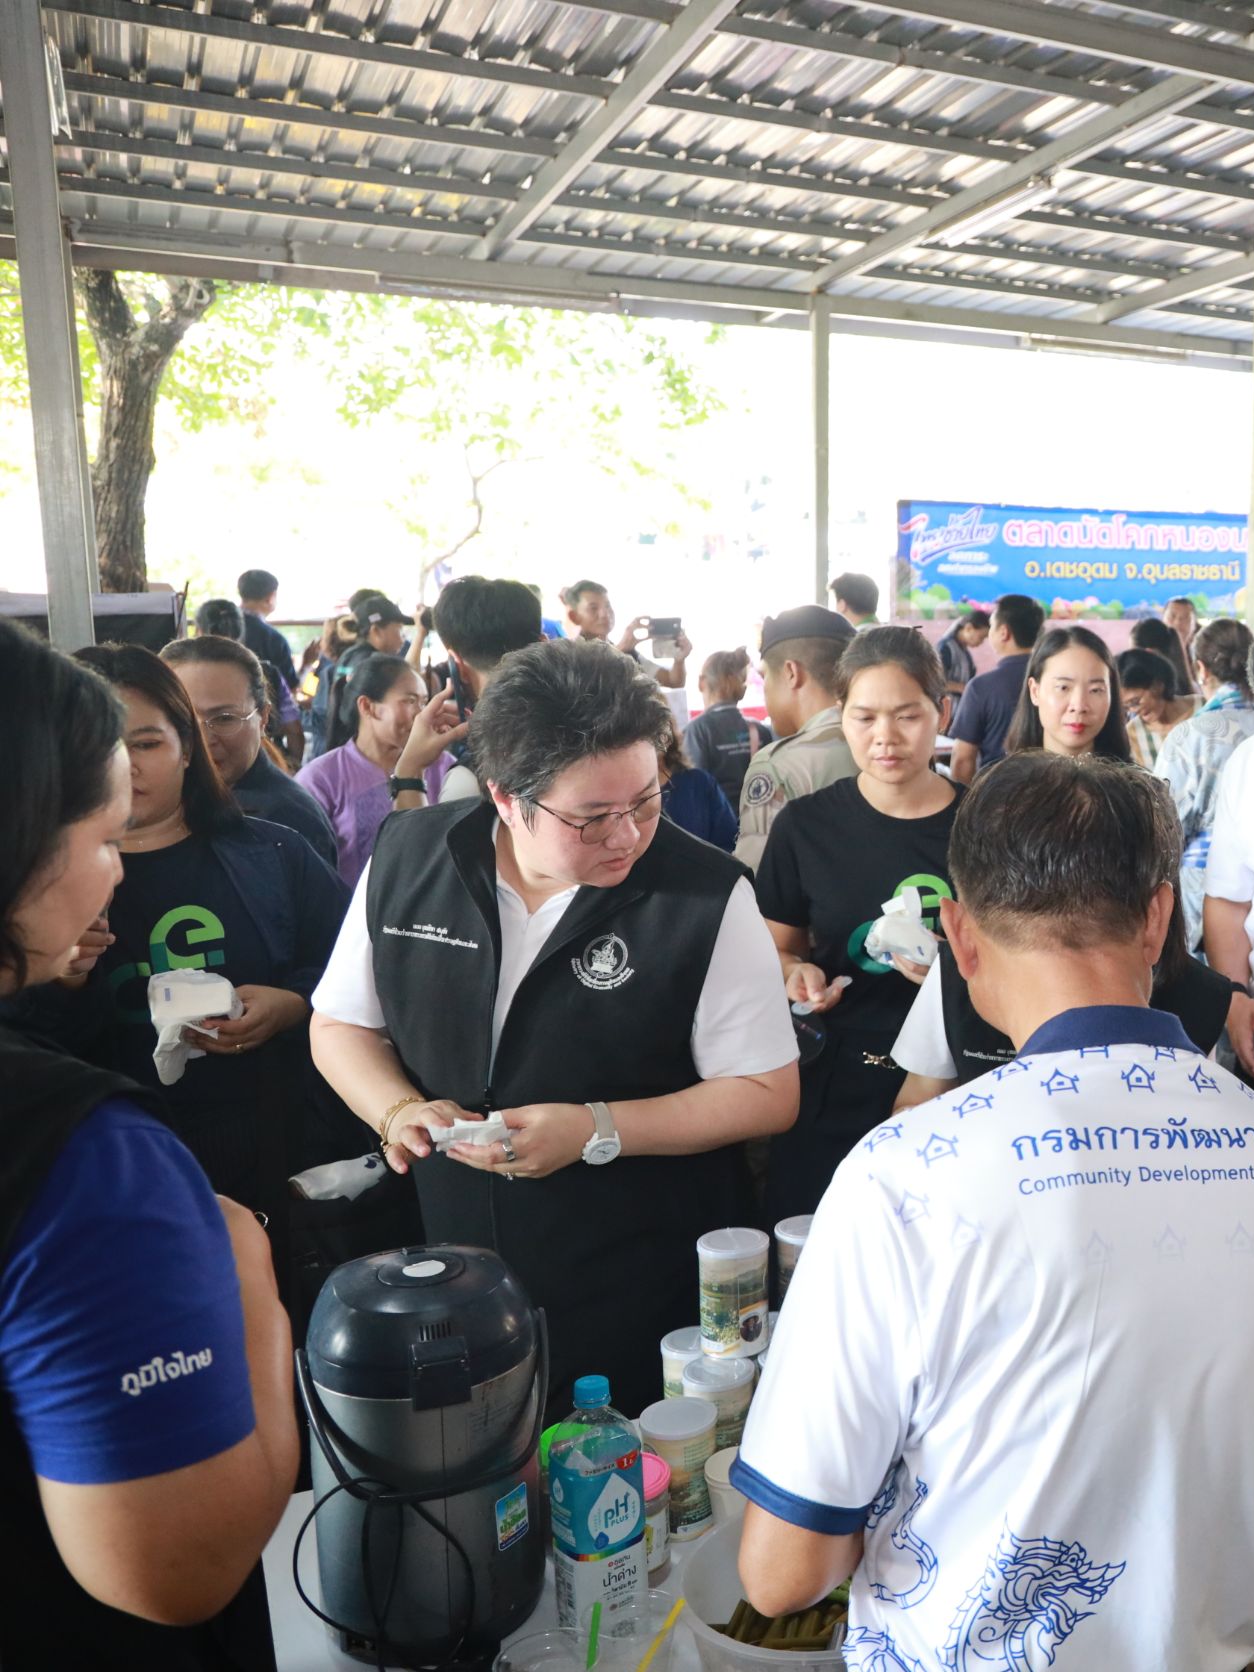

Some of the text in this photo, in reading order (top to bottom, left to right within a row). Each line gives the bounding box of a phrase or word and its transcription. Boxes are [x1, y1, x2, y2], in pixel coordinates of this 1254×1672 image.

[1003, 513, 1249, 552] ตลาดนัดโคกหนองน
[1024, 561, 1118, 584] อ.เดชอุดม
[1124, 560, 1241, 585] จ.อุบลราชธานี
[1018, 1167, 1131, 1196] Community
[121, 1347, 213, 1397] ภูมิใจไทย
[610, 1515, 629, 1527] PLUS
[602, 1565, 637, 1588] น้ำด่าง
